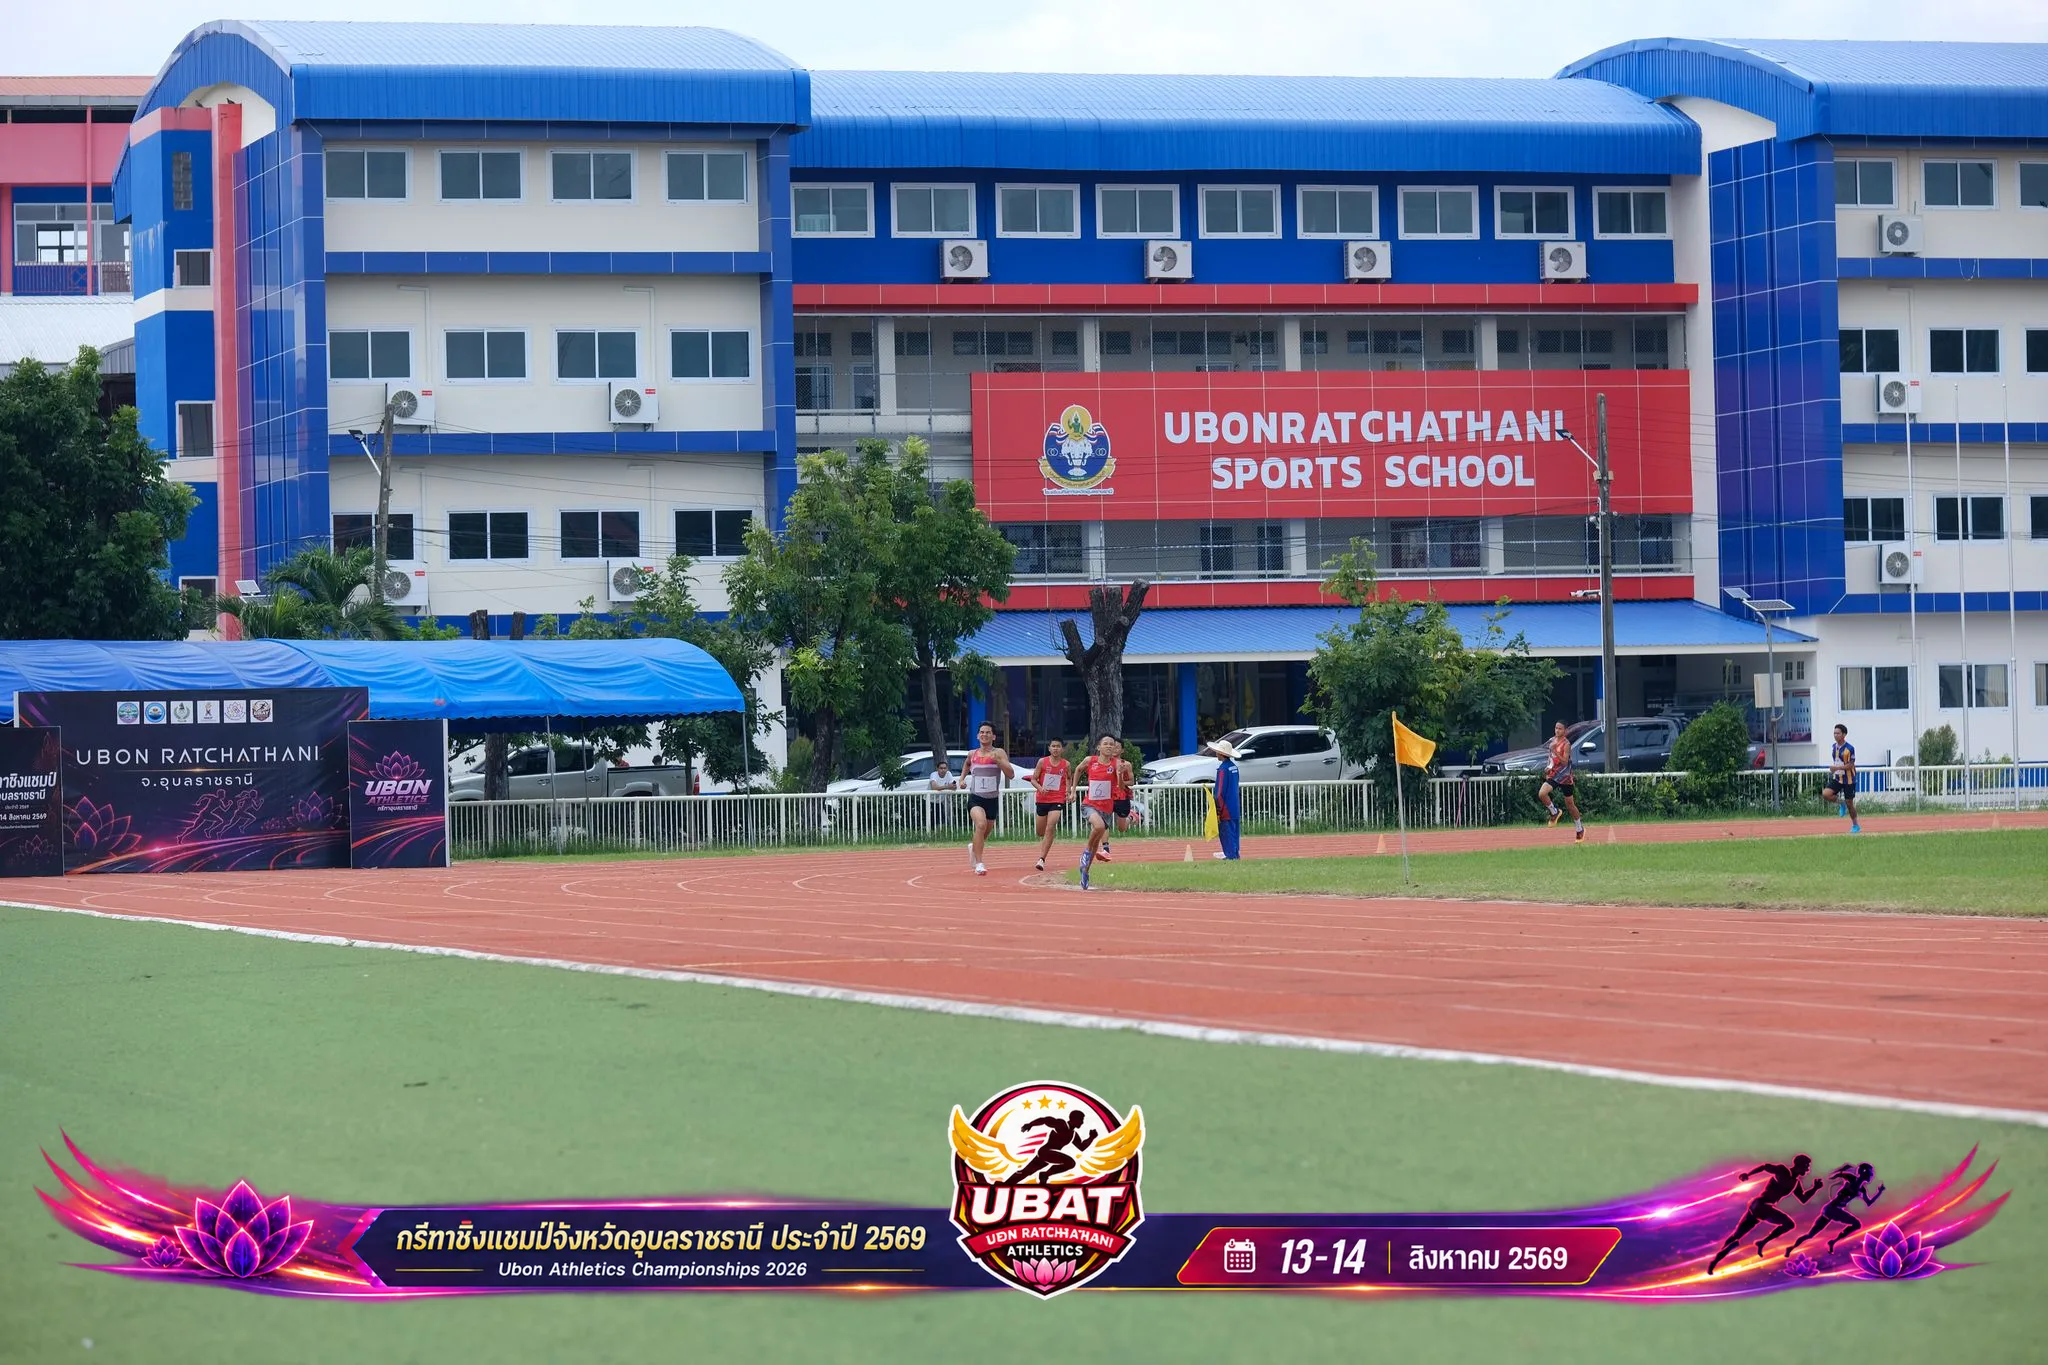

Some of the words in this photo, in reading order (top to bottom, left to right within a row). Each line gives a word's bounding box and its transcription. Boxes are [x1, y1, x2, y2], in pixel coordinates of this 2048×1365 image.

[1164, 410, 1565, 445] UBONRATCHATHANI
[1212, 456, 1363, 490] SPORTS
[1384, 454, 1535, 488] SCHOOL
[76, 748, 149, 765] UBON
[161, 745, 320, 764] RATCHATHANI
[364, 779, 433, 796] UBON
[980, 778, 988, 790] 1
[1047, 776, 1057, 787] 2
[1094, 783, 1103, 797] 6
[367, 795, 430, 805] ATHLETICS
